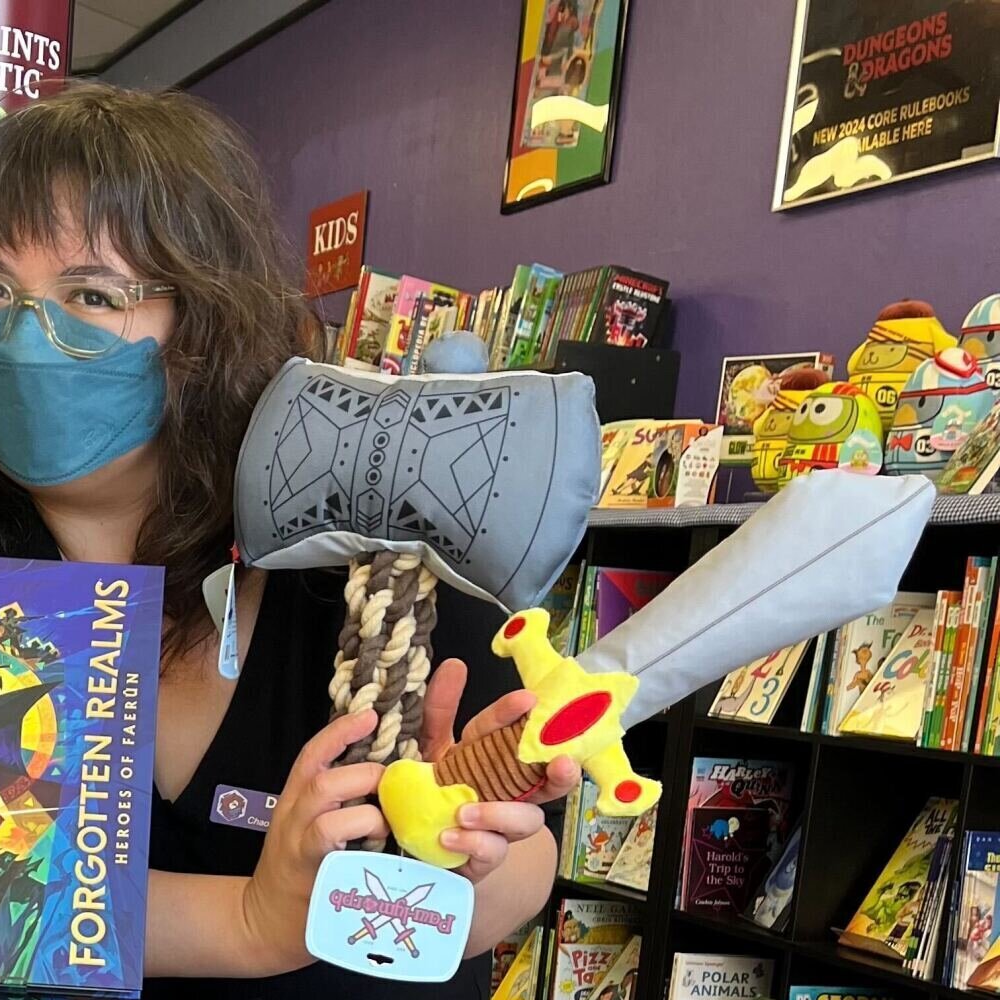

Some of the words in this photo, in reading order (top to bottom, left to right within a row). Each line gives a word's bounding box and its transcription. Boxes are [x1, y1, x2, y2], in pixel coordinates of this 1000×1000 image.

[842, 11, 949, 66] DUNGEONS
[860, 35, 953, 83] DRAGONS
[812, 123, 839, 147] NEW
[839, 117, 866, 139] 2024
[867, 108, 898, 130] CORE
[899, 86, 971, 122] RULEBOOKS
[902, 118, 934, 141] HERE
[313, 210, 360, 256] KIDS
[866, 614, 885, 627] The
[86, 579, 130, 720] REALMS
[120, 755, 134, 780] OF
[247, 816, 271, 829] Chao
[925, 809, 947, 823] ALL
[114, 789, 133, 865] HEROES
[68, 735, 113, 967] FORGOTTEN
[706, 851, 749, 863] Harold's
[709, 863, 731, 876] Trip
[734, 864, 745, 874] to
[706, 875, 724, 886] the
[726, 875, 745, 888] Sky
[571, 950, 612, 968] Pizz
[701, 970, 750, 985] POLAR
[690, 984, 758, 998] ANIMALS
